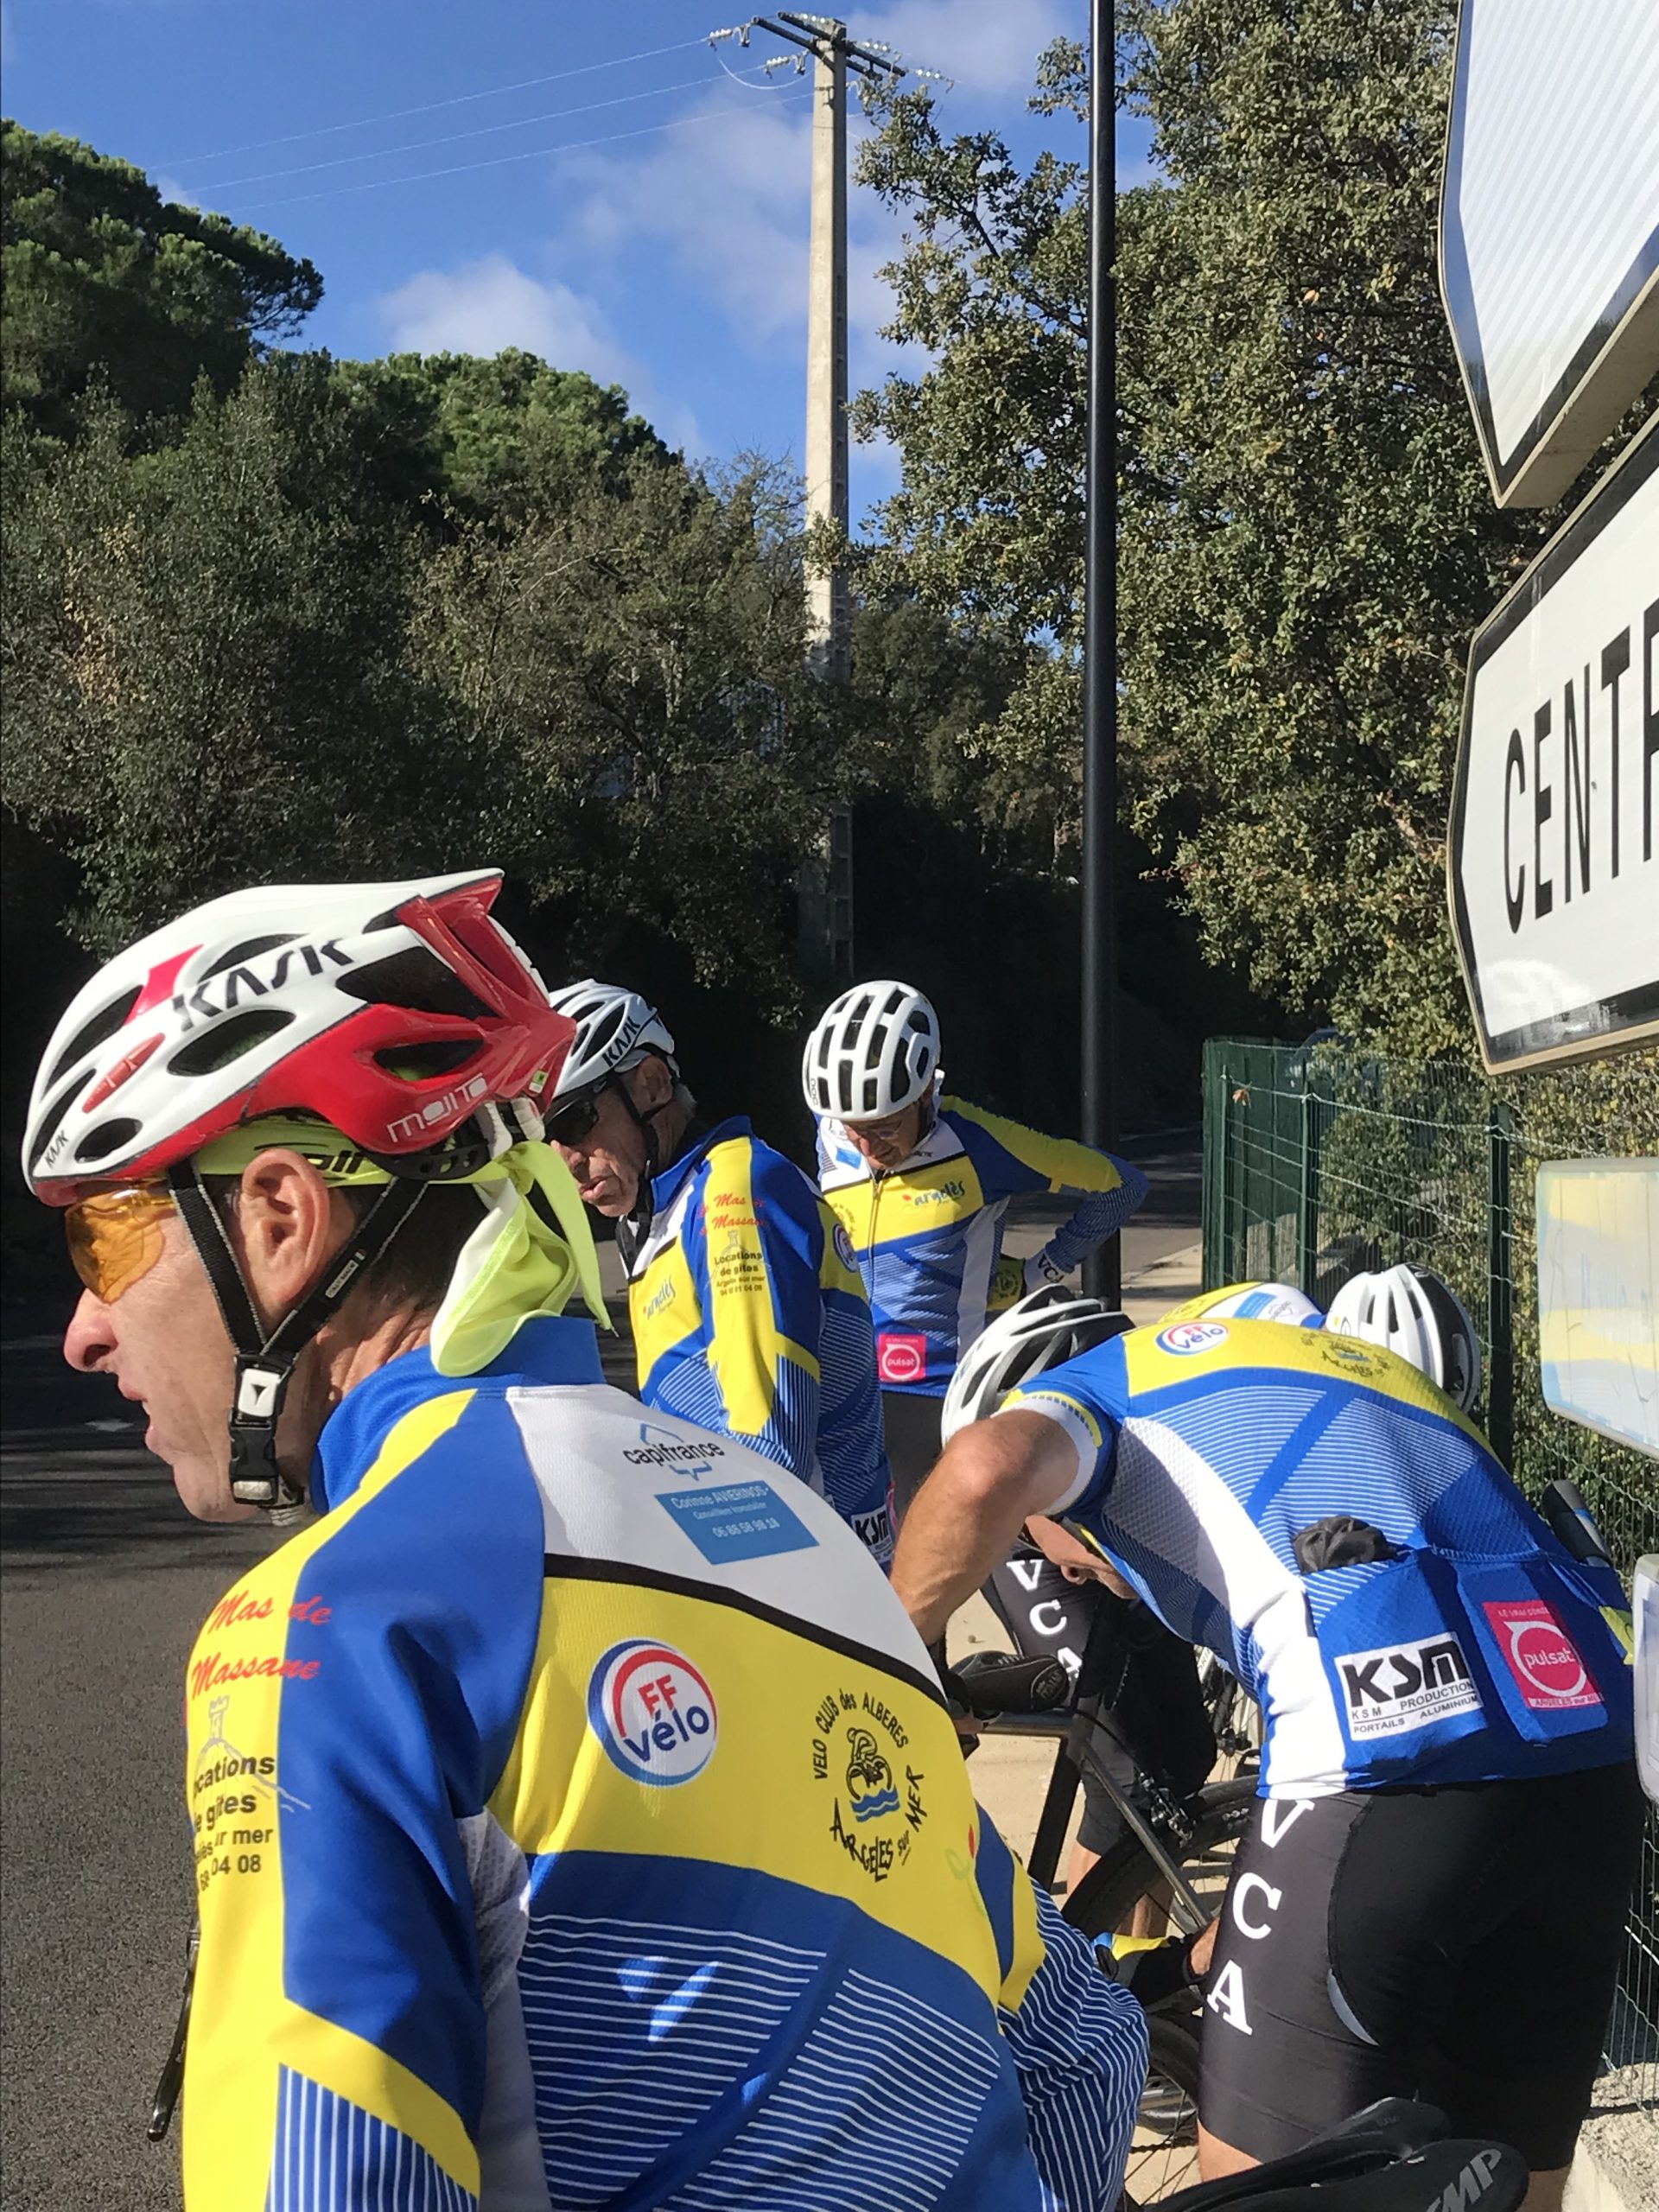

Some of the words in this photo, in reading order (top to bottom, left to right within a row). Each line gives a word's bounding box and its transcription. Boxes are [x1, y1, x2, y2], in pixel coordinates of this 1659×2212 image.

[172, 938, 354, 1032] KASK
[602, 1016, 640, 1067] KASK
[714, 1192, 746, 1207] Mas
[715, 1251, 762, 1265] Locations
[623, 1441, 725, 1466] capifrance
[207, 1590, 273, 1634] Mas
[288, 1596, 332, 1624] de
[192, 1652, 321, 1700] Massane
[1523, 1648, 1576, 1669] pulsat
[638, 1675, 677, 1717] FF
[816, 1695, 839, 1734] CLUB
[839, 1688, 857, 1710] des
[1354, 1718, 1405, 1733] PORTAILS
[1420, 1695, 1478, 1719] ALUMINIUM
[624, 1705, 709, 1764] vélo
[863, 1692, 908, 1748] ALBERES
[812, 1738, 828, 1779] VELO
[232, 1829, 274, 1844] mer
[830, 1797, 893, 1883] ARGELES
[906, 1765, 927, 1833] MER
[212, 1856, 231, 1876] 04
[238, 1854, 261, 1873] 08
[1207, 1798, 1314, 2035] VCA
[1427, 2148, 1502, 2212] MP
